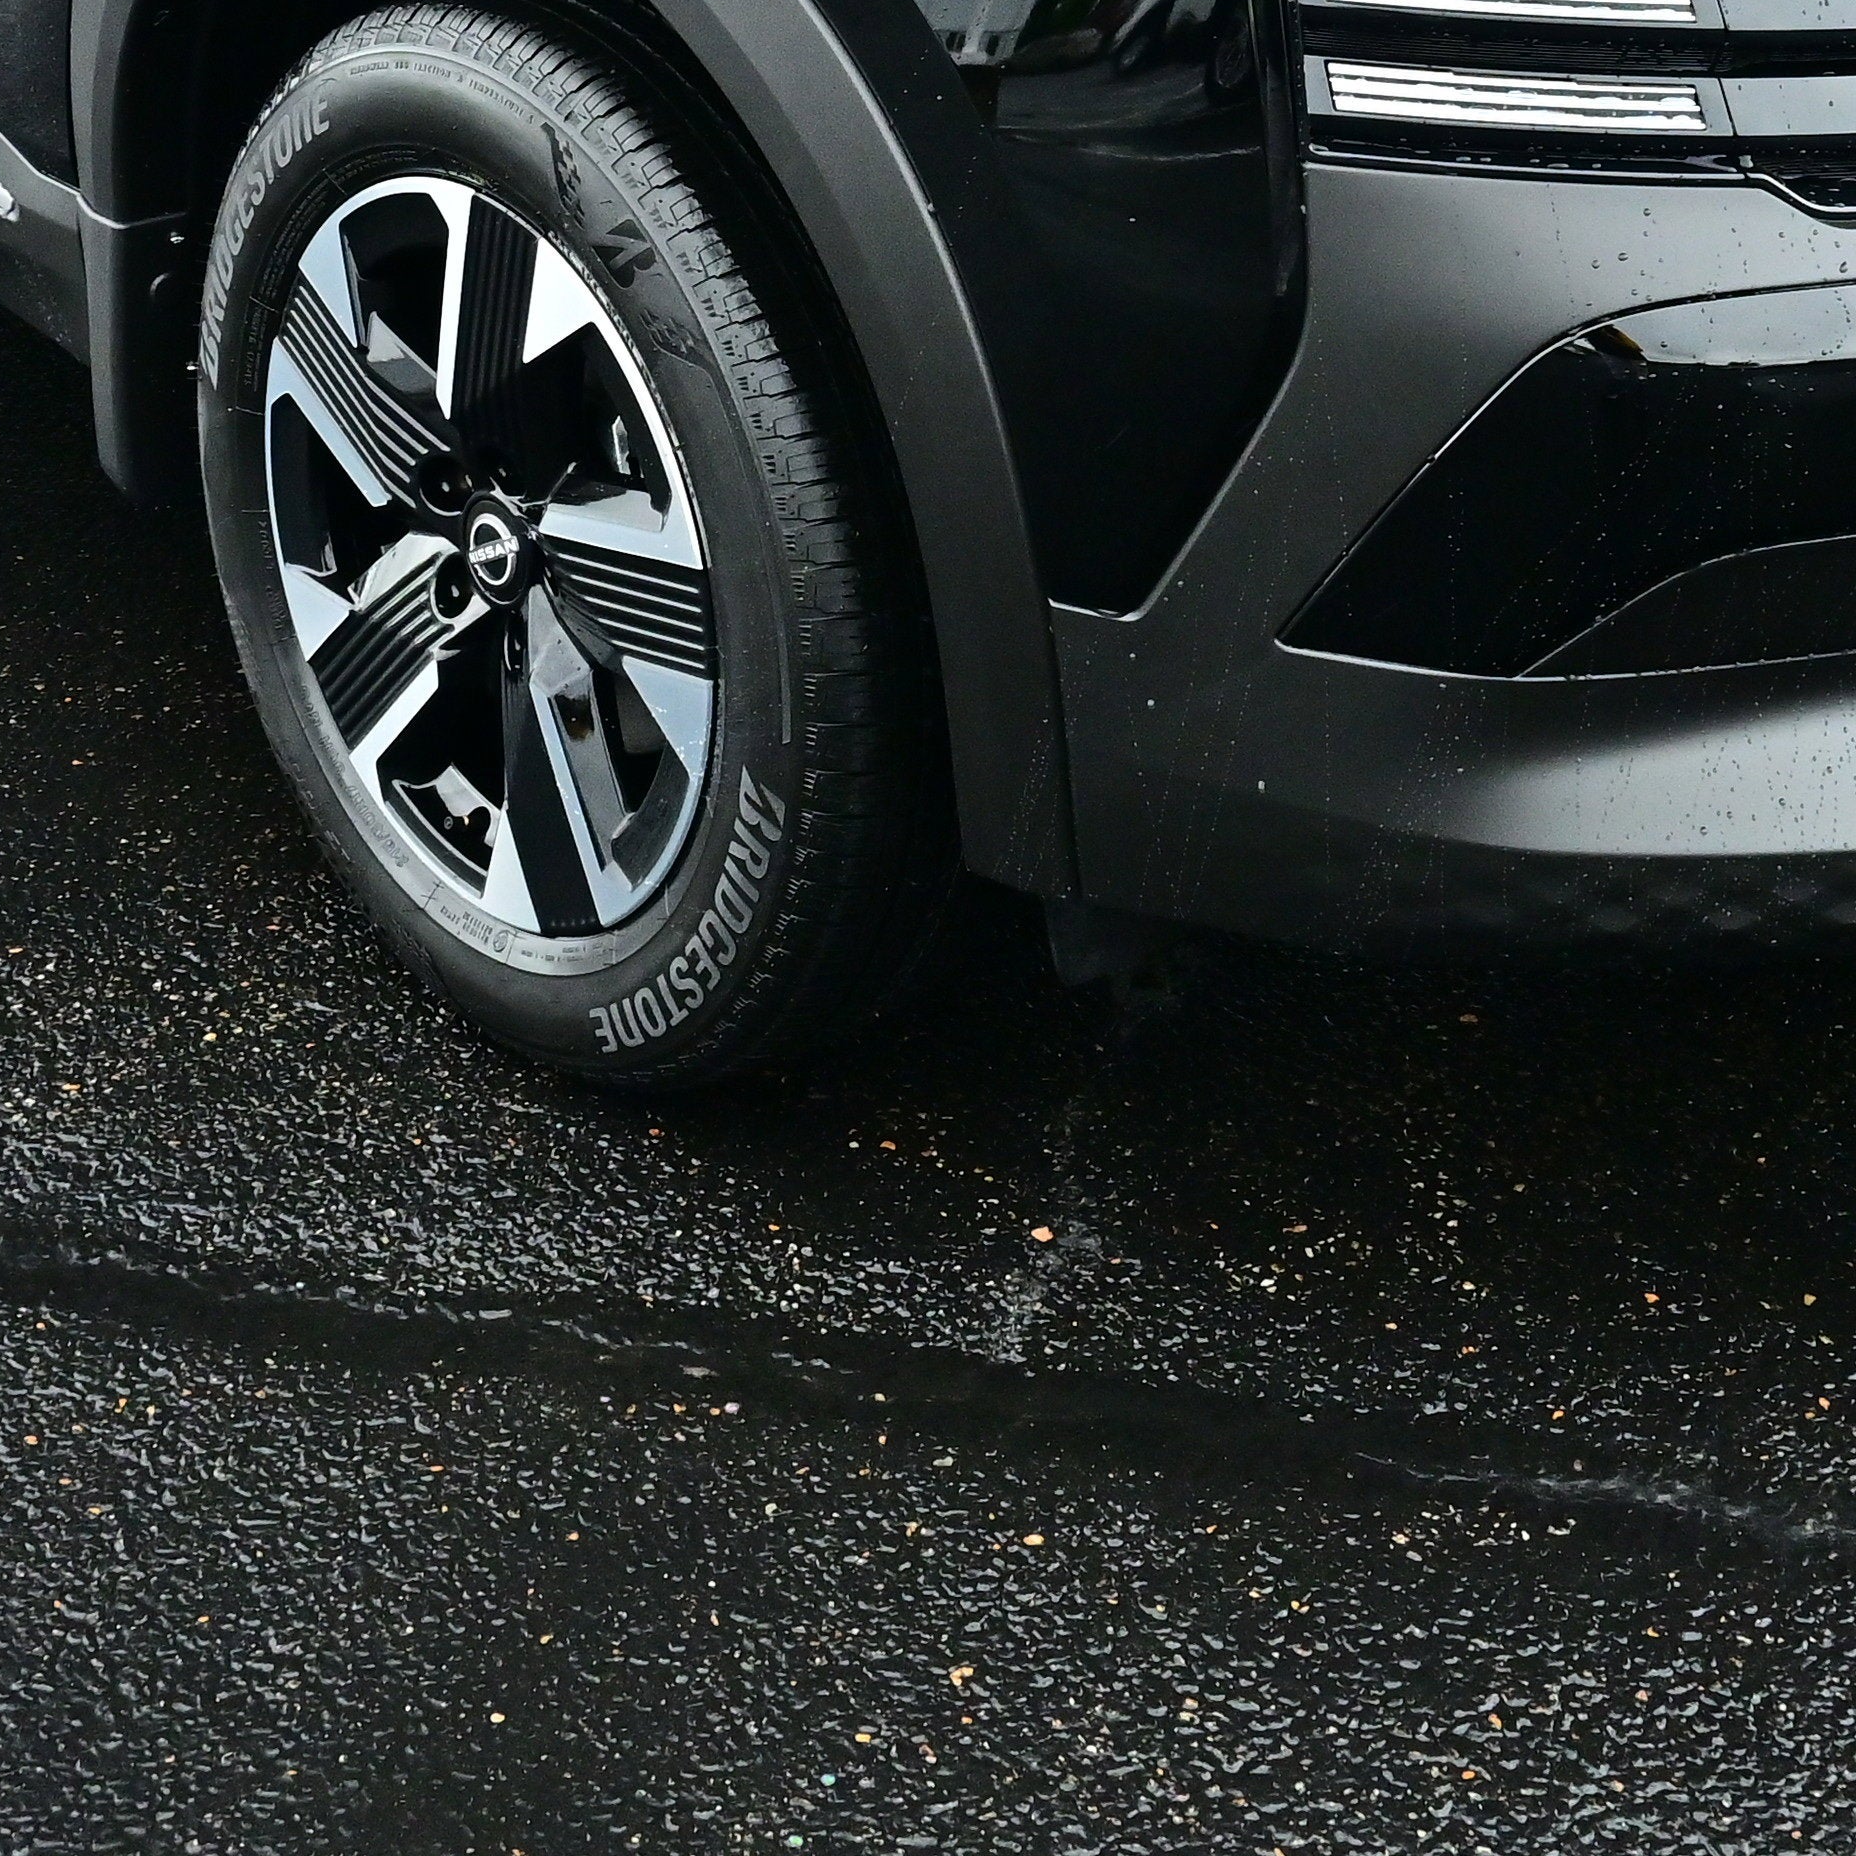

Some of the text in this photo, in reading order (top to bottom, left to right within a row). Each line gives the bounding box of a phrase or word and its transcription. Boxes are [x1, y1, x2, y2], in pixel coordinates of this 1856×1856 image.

[200, 92, 331, 391] BRIDGESTONE
[468, 538, 518, 564] NISSAN
[588, 763, 786, 1054] BRIDGESTONE
